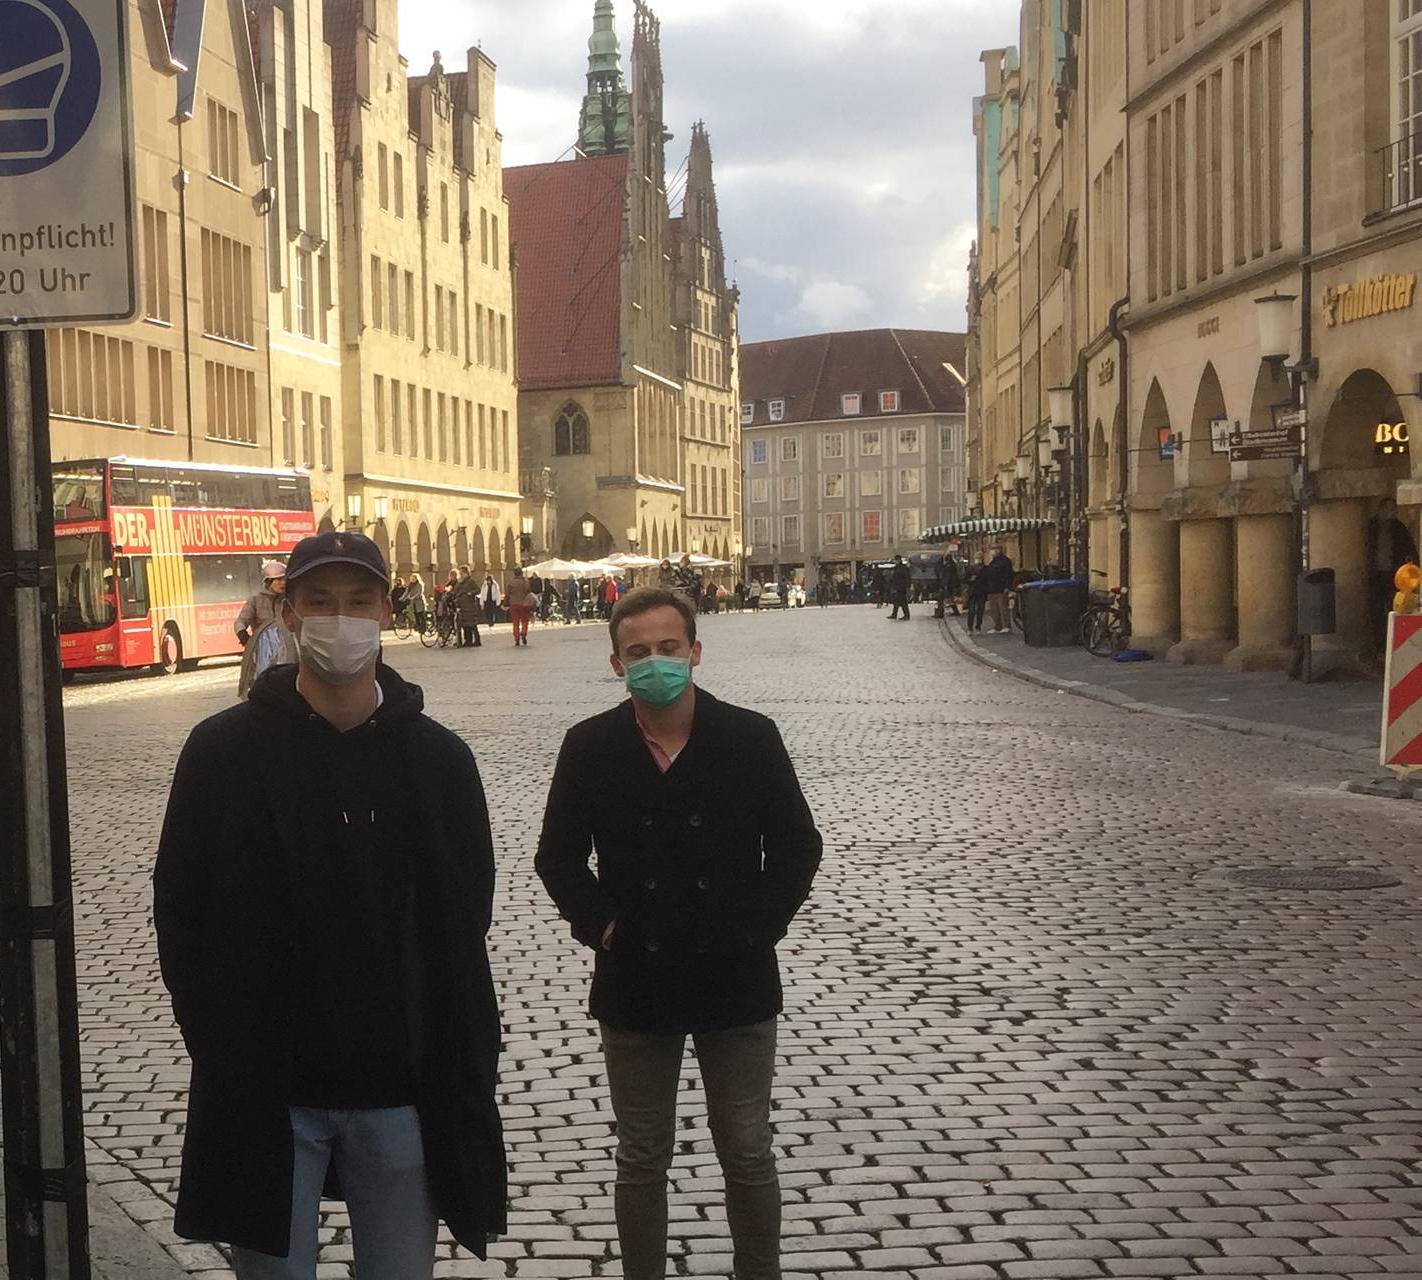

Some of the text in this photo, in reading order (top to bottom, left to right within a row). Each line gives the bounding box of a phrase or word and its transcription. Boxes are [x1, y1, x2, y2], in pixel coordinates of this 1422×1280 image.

[39, 267, 91, 293] Uhr
[1337, 272, 1416, 325] Tollkötter
[113, 512, 279, 547] DER MÜNSTERBUS
